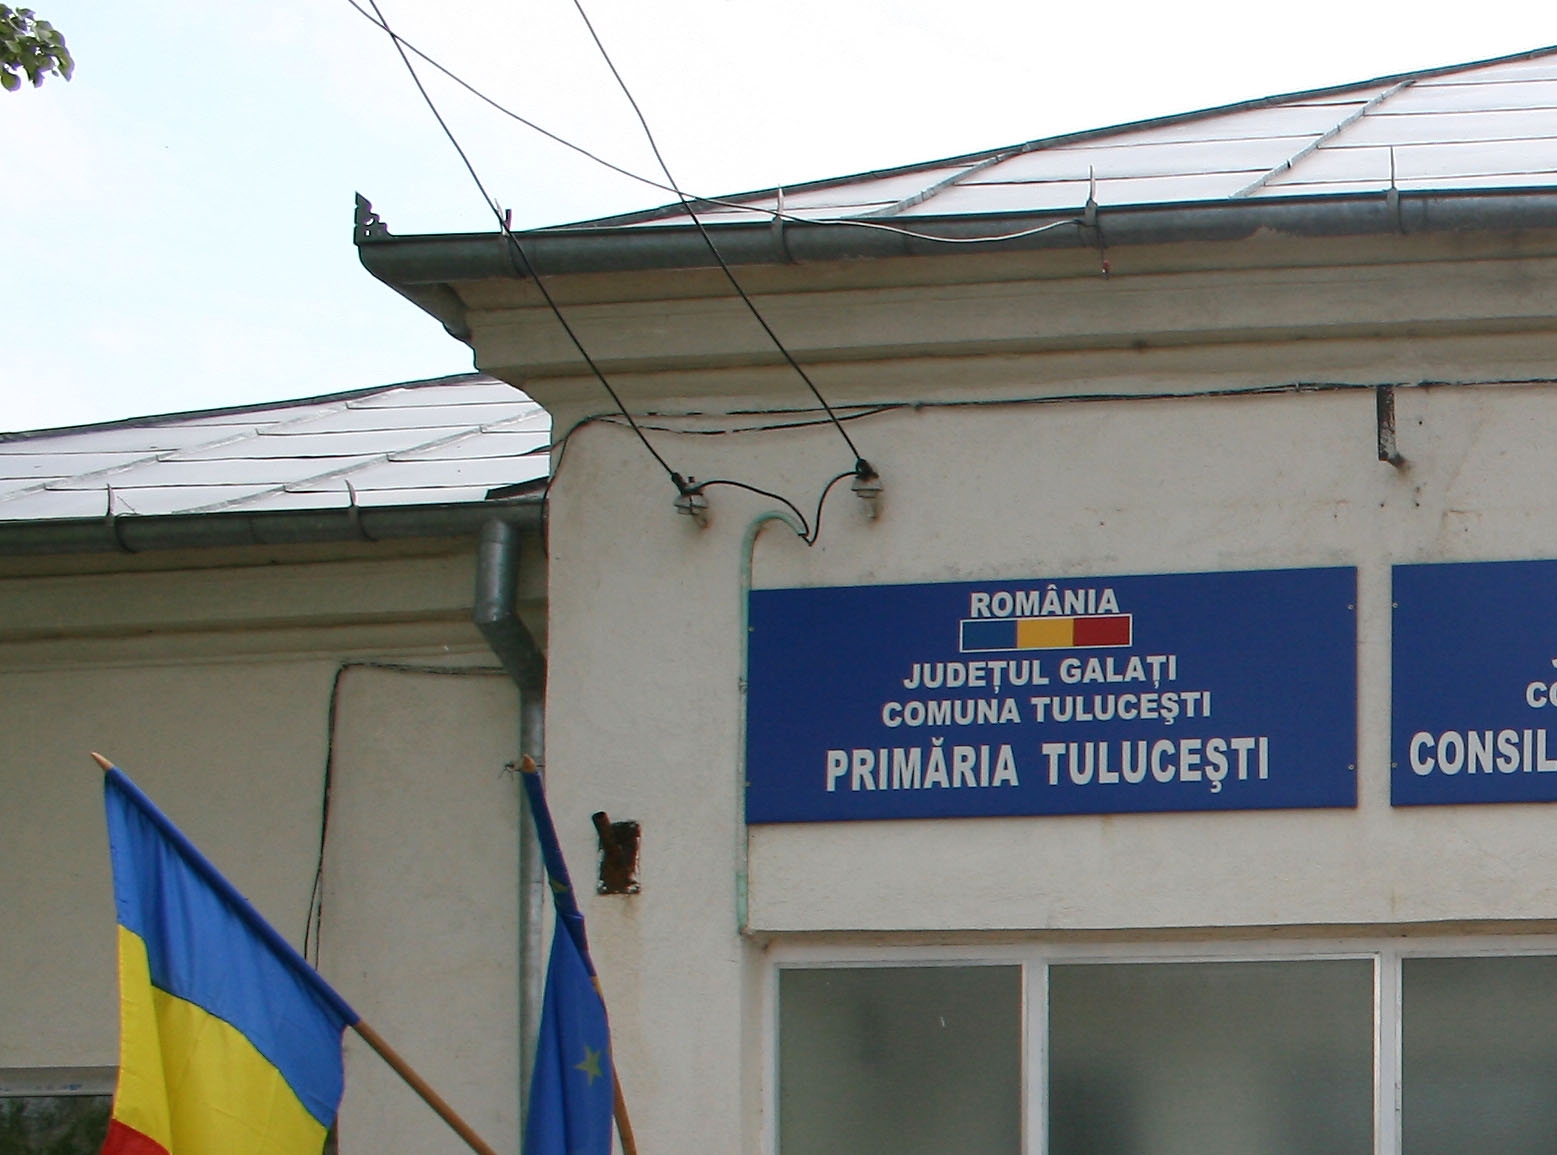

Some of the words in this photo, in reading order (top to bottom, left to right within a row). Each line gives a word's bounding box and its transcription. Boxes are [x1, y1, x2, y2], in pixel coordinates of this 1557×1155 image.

[970, 584, 1120, 617] ROMÂNIA
[882, 697, 1020, 728] COMUNA
[826, 736, 1019, 792] PRIMĂRIA
